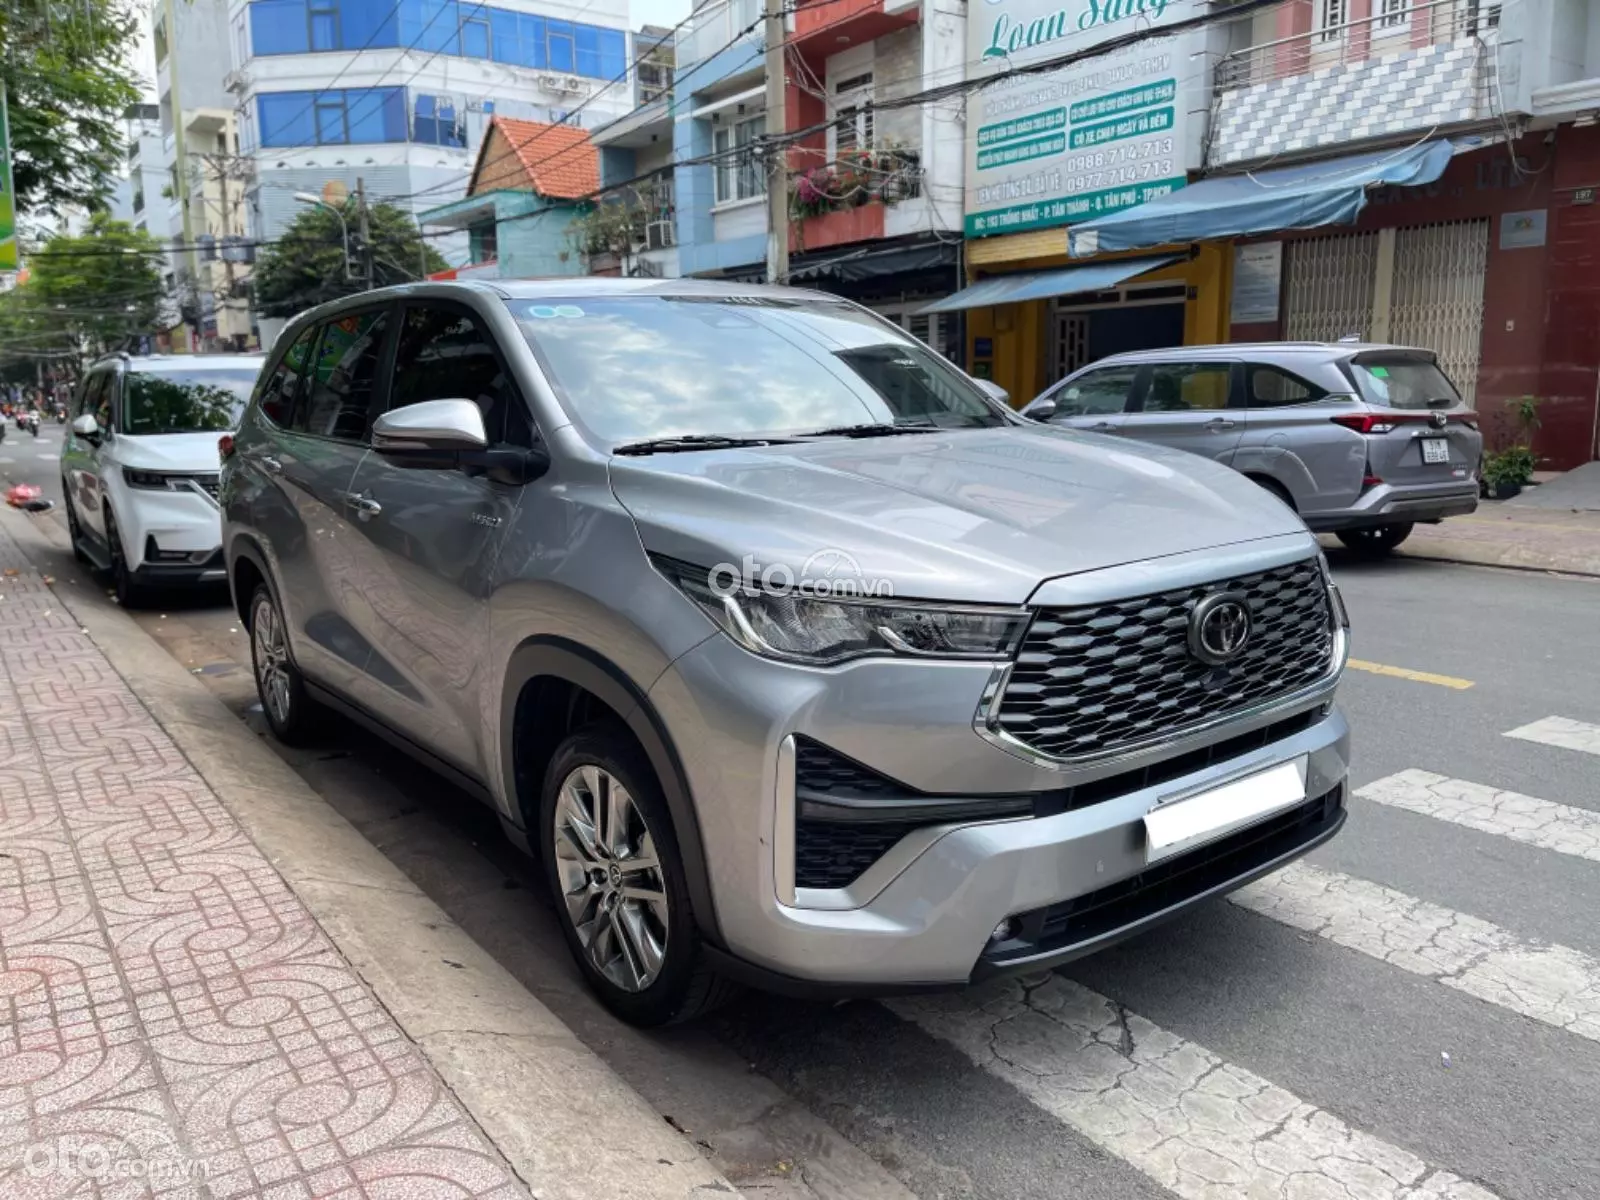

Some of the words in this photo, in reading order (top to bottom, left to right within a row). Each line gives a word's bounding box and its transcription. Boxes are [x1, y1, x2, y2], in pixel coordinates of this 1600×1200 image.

[982, 10, 1066, 62] Loan
[1067, 138, 1173, 173] 0988.714.713
[1067, 160, 1171, 193] 0977.714.713
